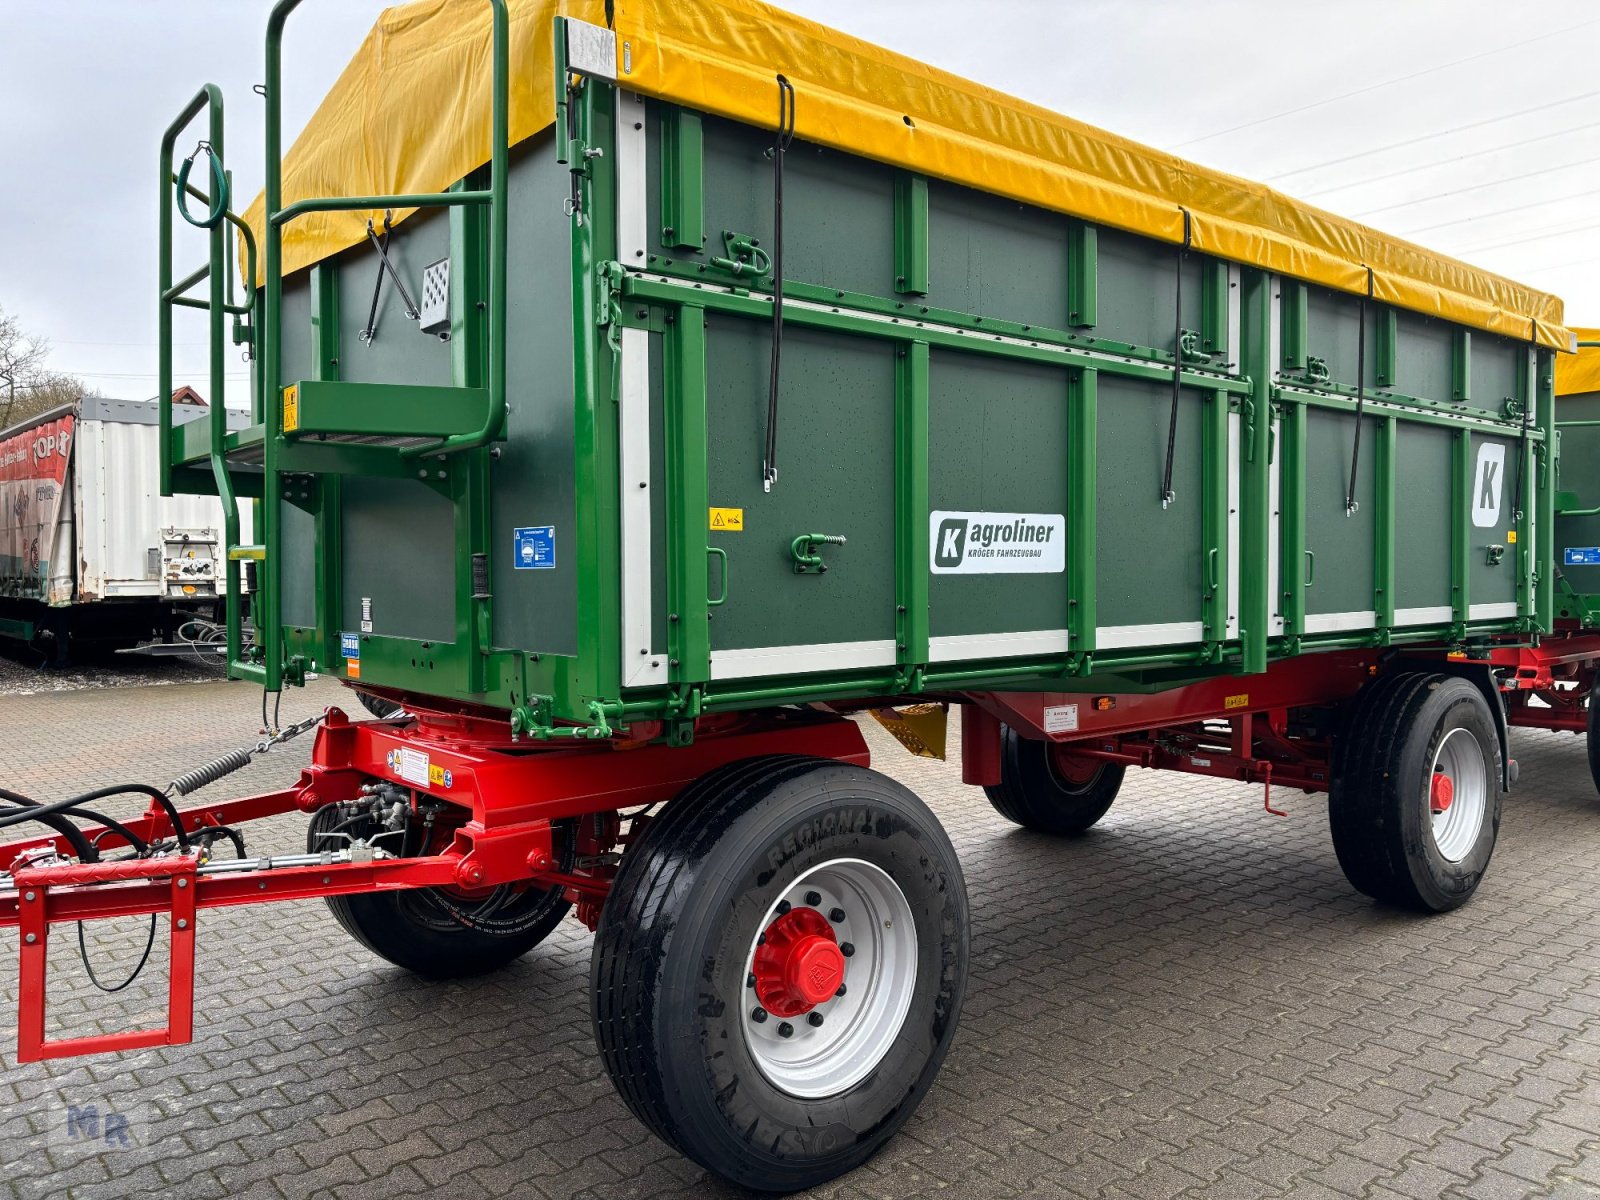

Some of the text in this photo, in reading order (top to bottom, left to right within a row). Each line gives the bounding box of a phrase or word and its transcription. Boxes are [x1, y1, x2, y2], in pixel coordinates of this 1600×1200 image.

[1479, 460, 1499, 510] K
[941, 528, 962, 558] K
[970, 518, 1054, 548] agroliner
[967, 547, 1042, 558] KRÖGER FAHRZEUGBAU
